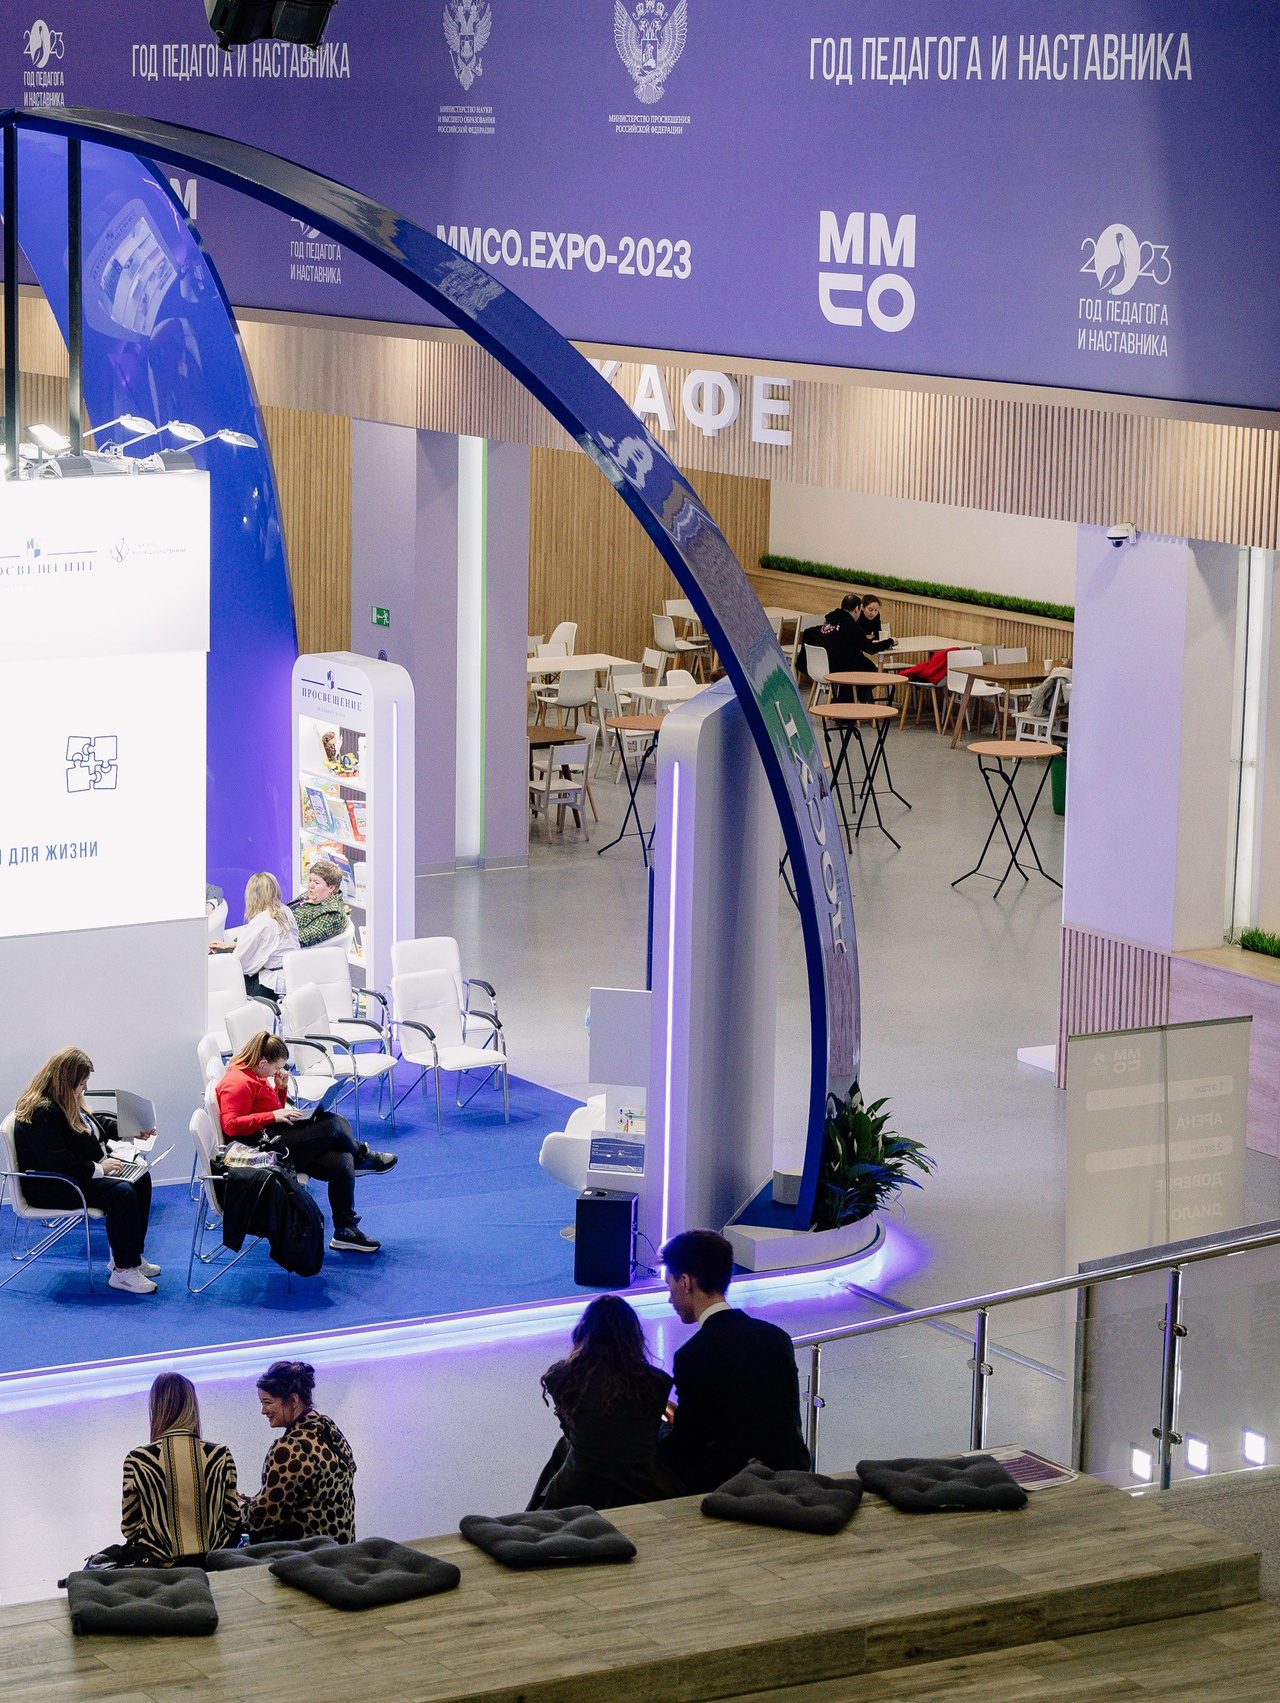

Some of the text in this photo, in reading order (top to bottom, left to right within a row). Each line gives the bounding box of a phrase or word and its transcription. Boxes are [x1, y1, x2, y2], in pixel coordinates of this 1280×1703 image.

[132, 44, 158, 81] ГОД
[237, 44, 246, 77] И
[252, 43, 350, 78] НАСТАВНИКА
[809, 33, 1192, 85] ГОД ПЕДАГОГА И НАСТАВНИКА
[23, 71, 65, 87] ГОД ПЕДАГОГА
[23, 91, 65, 107] И НАСТАВНИКА
[608, 114, 690, 124] МИНИСТЕРСТВО ПРОСВЕЩЕНИЯ
[615, 124, 683, 134] РОССИЙСКОЙ ФЕДЕРАЦИИ
[290, 241, 341, 261] ГОД ПЕДАГОГА
[290, 263, 341, 284] И НАСТАВНИКА
[1079, 298, 1169, 326] ГОД ПЕДАГОГА
[1077, 328, 1168, 357] И НАСТАВНИКА
[302, 688, 361, 711] ПРОСВЕЩЕНИЕ
[8, 846, 39, 866] ДЛЯ
[45, 841, 98, 861] ЖИЗНИ
